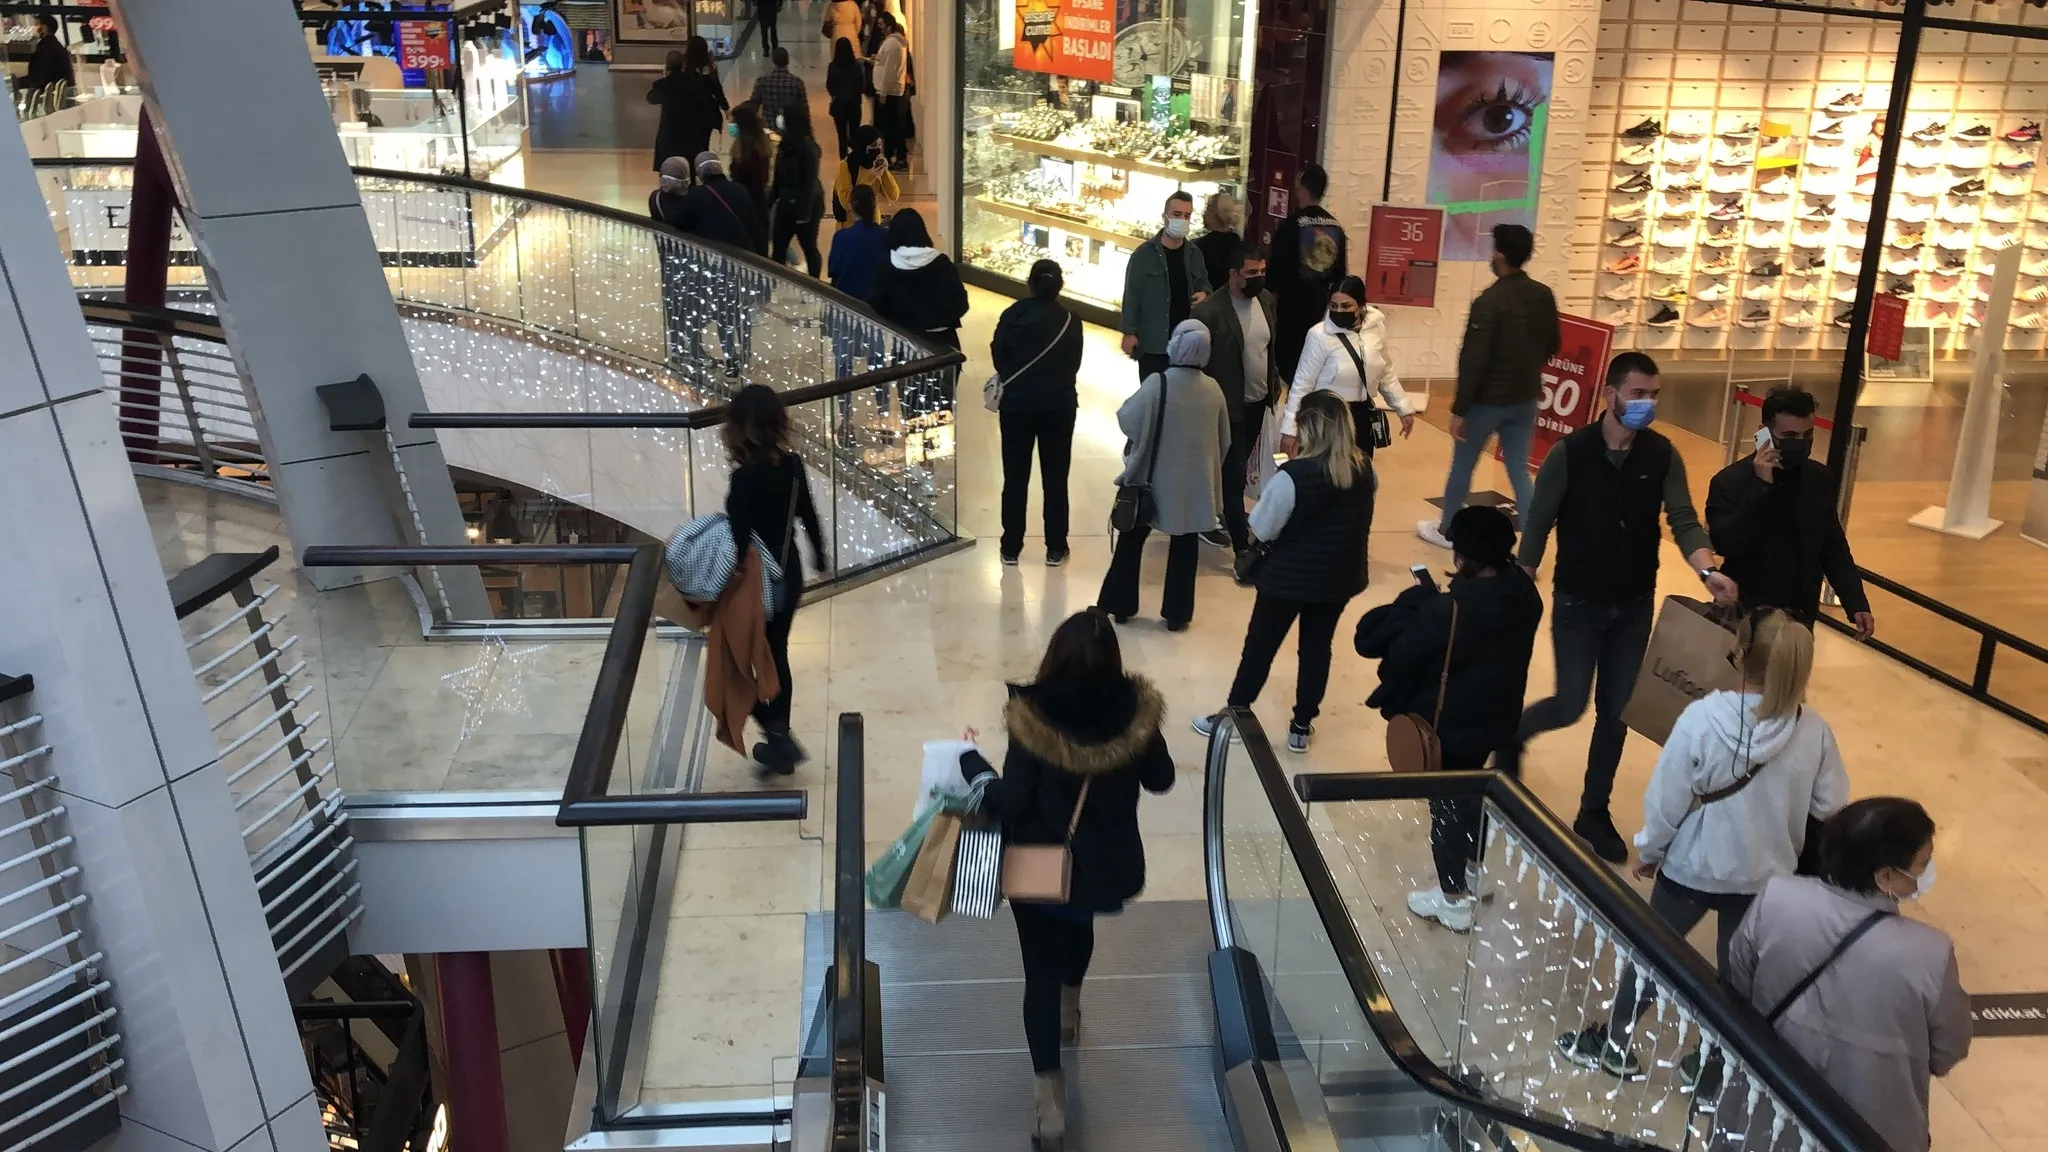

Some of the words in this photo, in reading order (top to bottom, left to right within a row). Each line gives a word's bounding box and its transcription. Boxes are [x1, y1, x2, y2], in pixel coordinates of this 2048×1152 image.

[1063, 36, 1111, 62] BAŞLADI
[1400, 221, 1423, 241] 36
[1537, 373, 1580, 417] 50
[1534, 416, 1574, 435] DİRİM
[1981, 1007, 2046, 1020] dikkat
